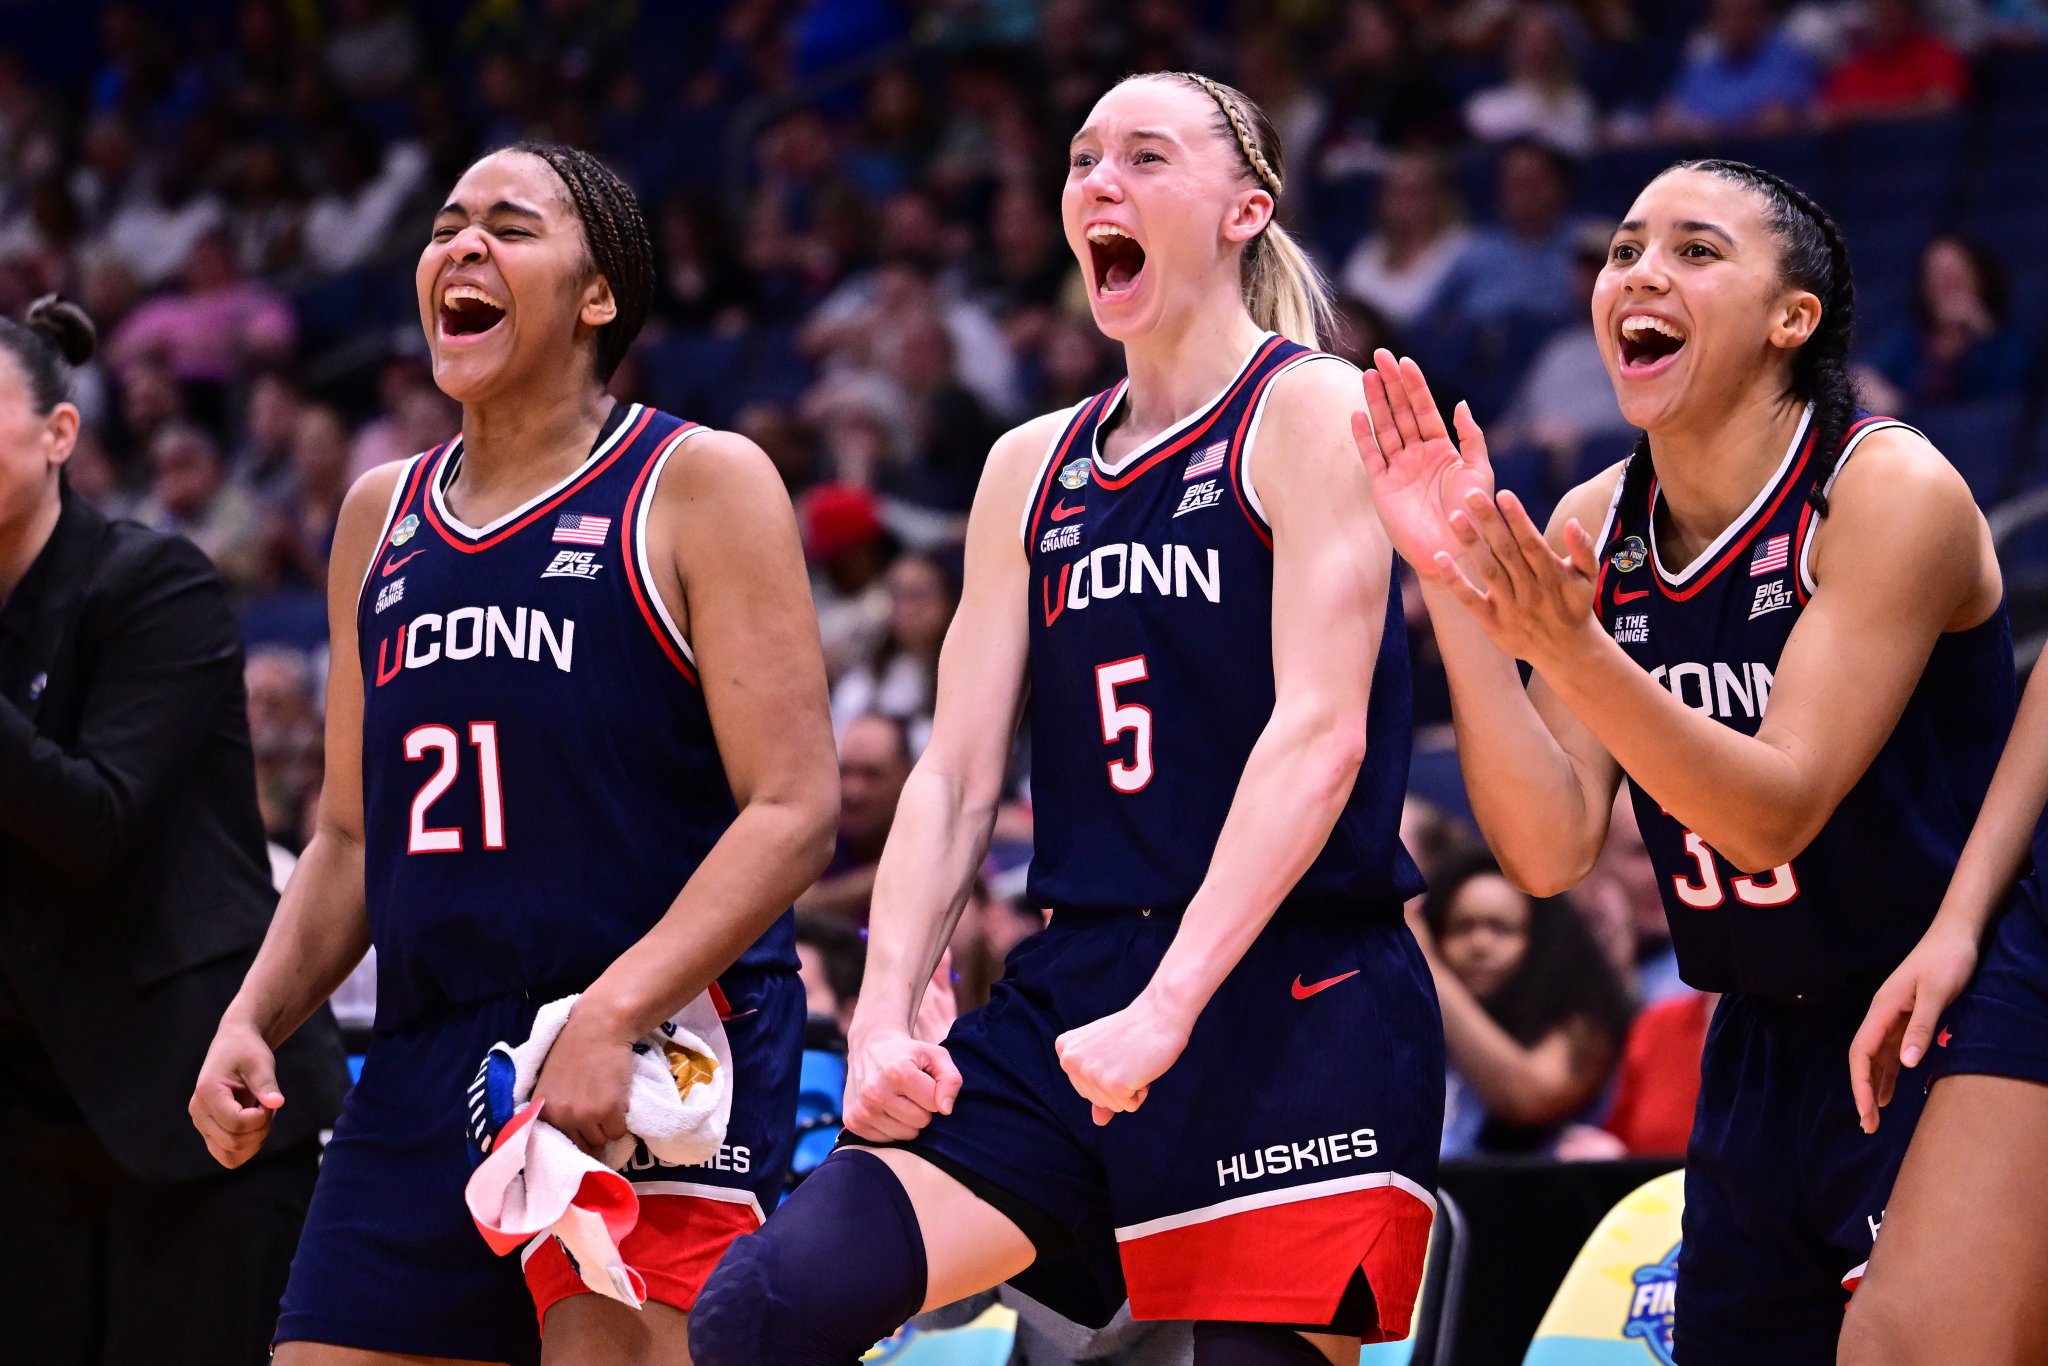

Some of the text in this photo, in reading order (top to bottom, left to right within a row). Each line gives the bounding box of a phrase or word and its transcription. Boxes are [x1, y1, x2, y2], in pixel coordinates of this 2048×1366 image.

[1177, 488, 1225, 511] EAST
[1183, 479, 1217, 499] BIG
[1044, 523, 1084, 539] BE THE
[1040, 532, 1081, 553] CHANGE
[553, 550, 596, 564] BIG
[545, 561, 604, 575] EAST
[389, 576, 406, 593] THE
[1043, 541, 1221, 627] UCONN
[1755, 579, 1784, 599] BIG
[375, 587, 405, 615] CHANGE
[1751, 590, 1793, 612] EAST
[1625, 615, 1649, 629] THE
[1615, 628, 1650, 643] HANGE
[376, 606, 575, 687] UCONN
[1095, 654, 1154, 794] 5
[403, 721, 506, 855] 21
[1216, 1128, 1378, 1187] HUSKIES
